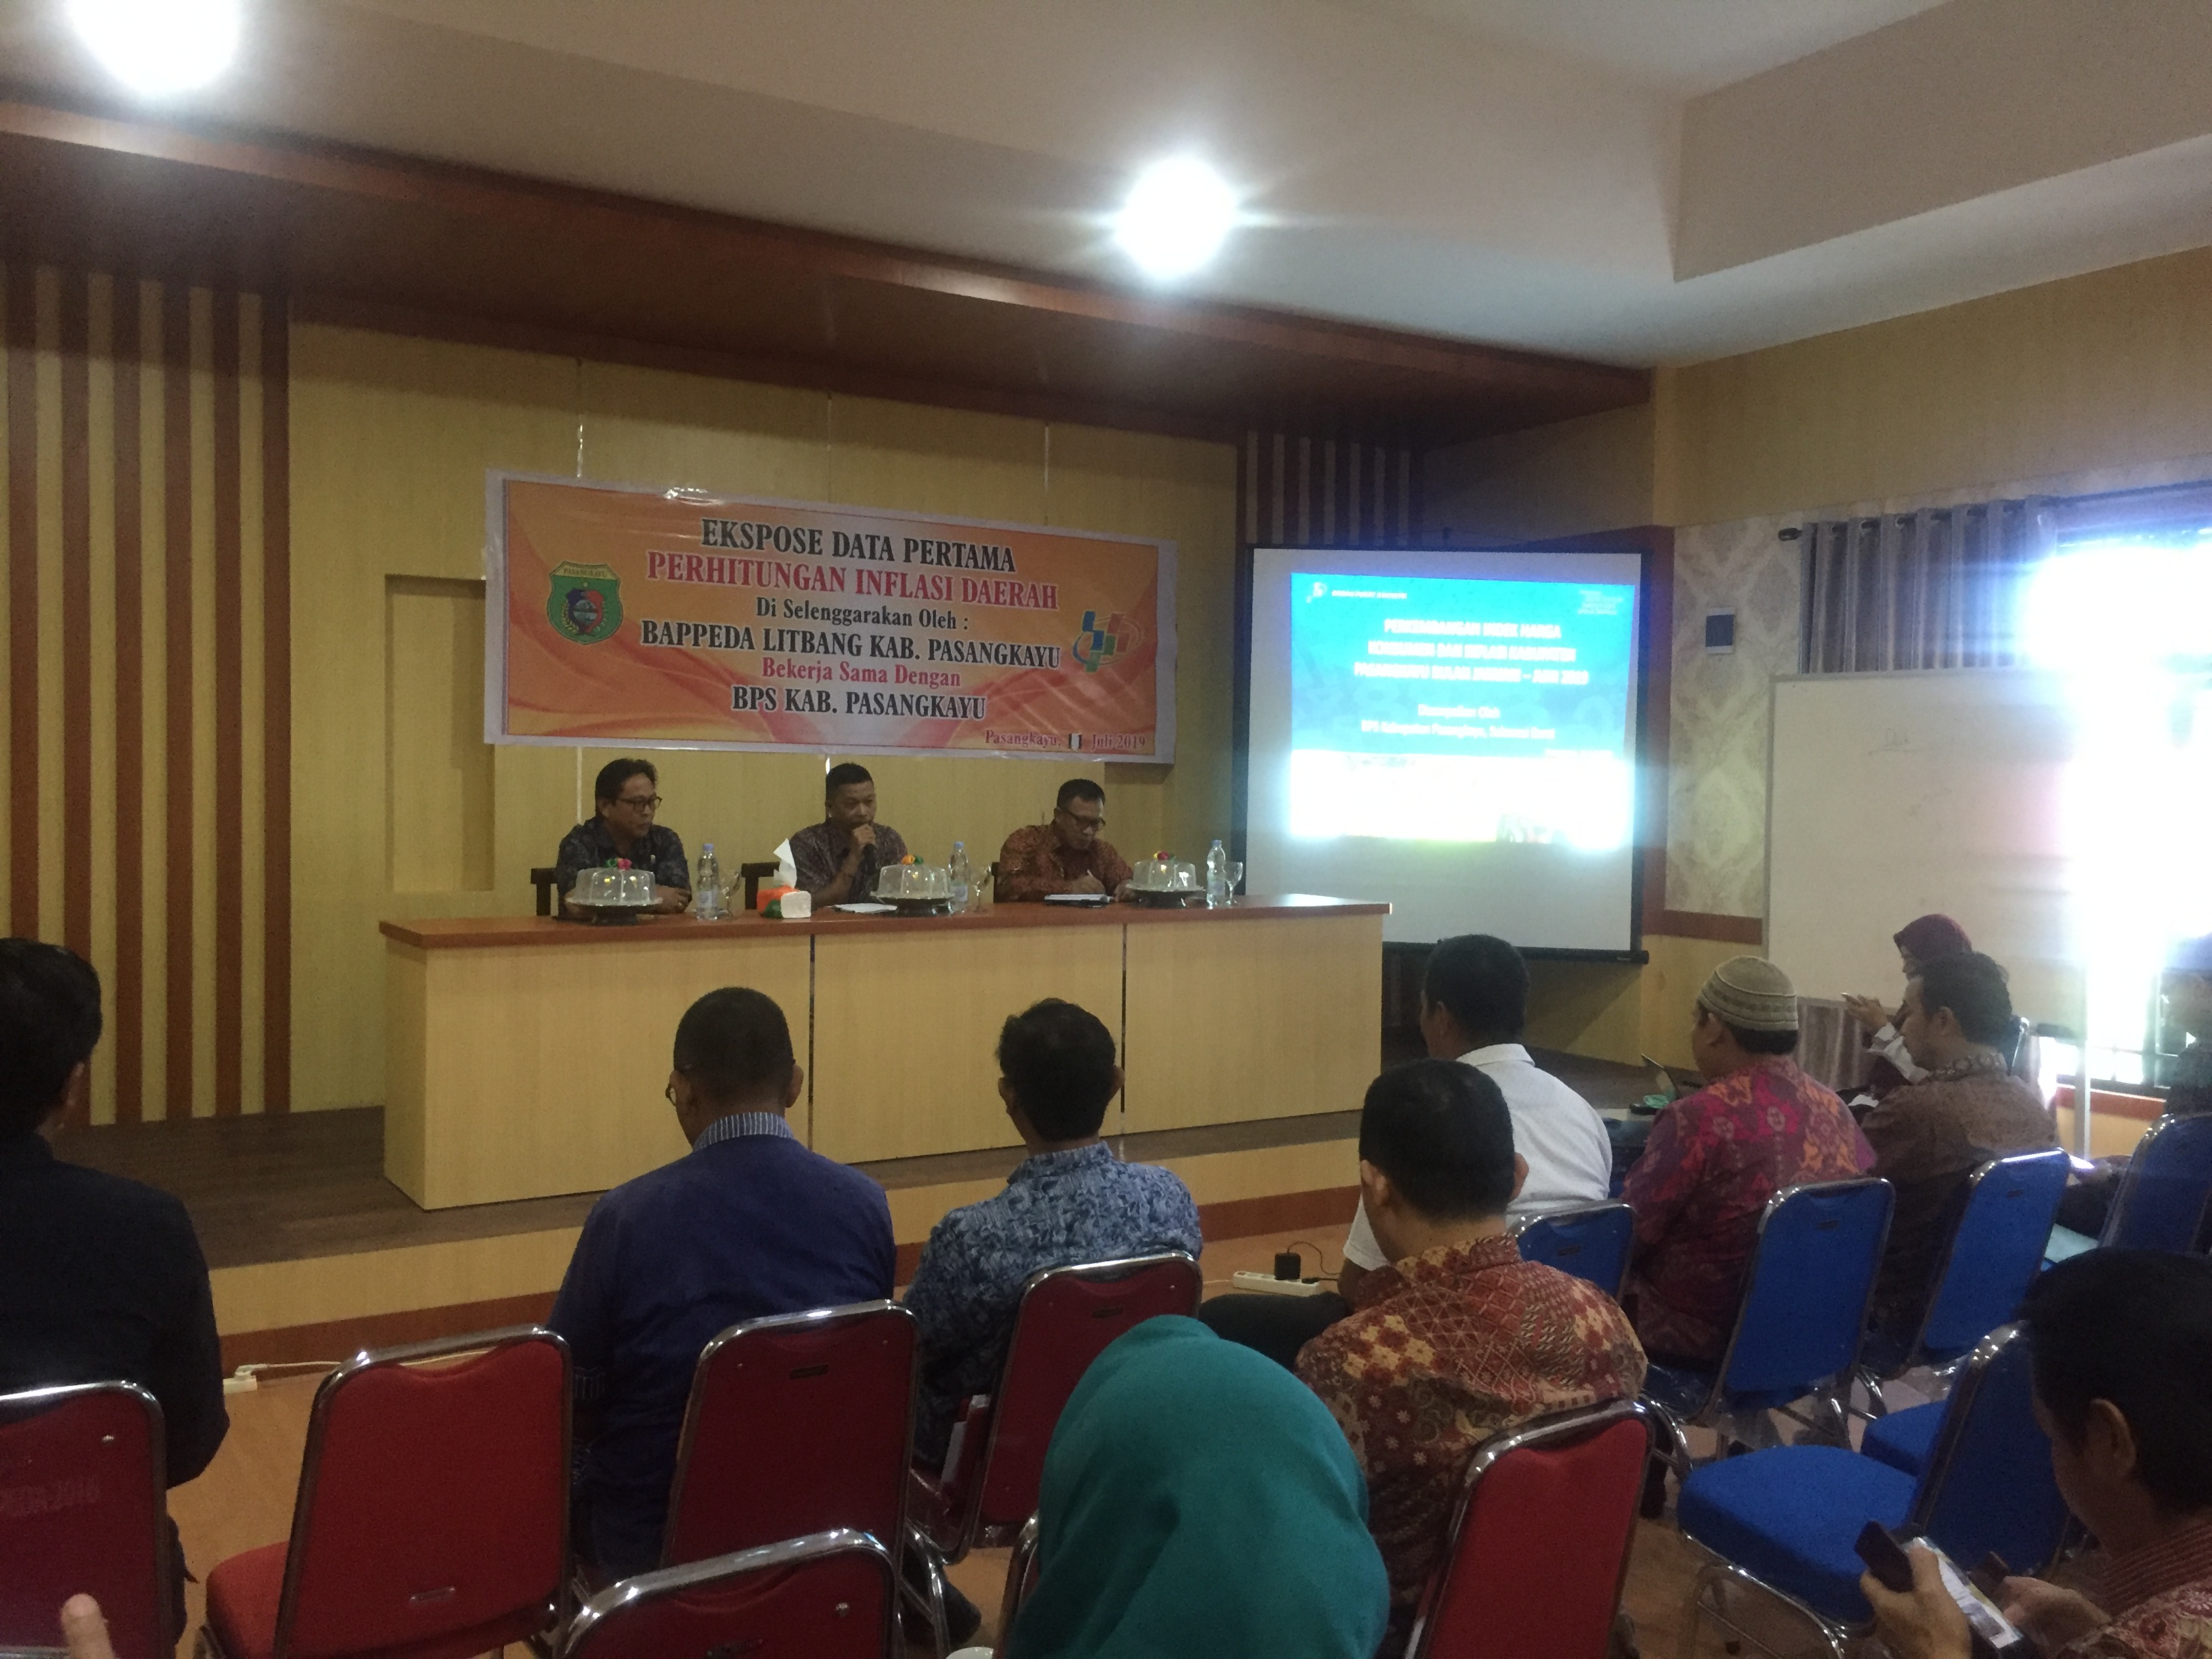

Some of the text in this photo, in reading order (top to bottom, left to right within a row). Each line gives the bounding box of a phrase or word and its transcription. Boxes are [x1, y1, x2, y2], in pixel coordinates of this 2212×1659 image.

[701, 518, 1015, 572] EKSPOSE DATA PERTAMA
[647, 551, 1058, 609] PERHITUNGAN INFLASI DAERAH
[756, 596, 777, 617] Di
[783, 598, 912, 626] Selenggarakan
[918, 609, 956, 630] Oleh
[642, 620, 1061, 669] BAPPEDA LITBANG KAB. PASANGKAYU
[762, 657, 961, 689] Bekerja Sama Dengan
[733, 686, 987, 719] BPS KAB. PASANGKAYU
[985, 729, 1062, 749] Pasangkayu,
[1090, 734, 1112, 750] Juli
[1116, 735, 1146, 749] 2019
